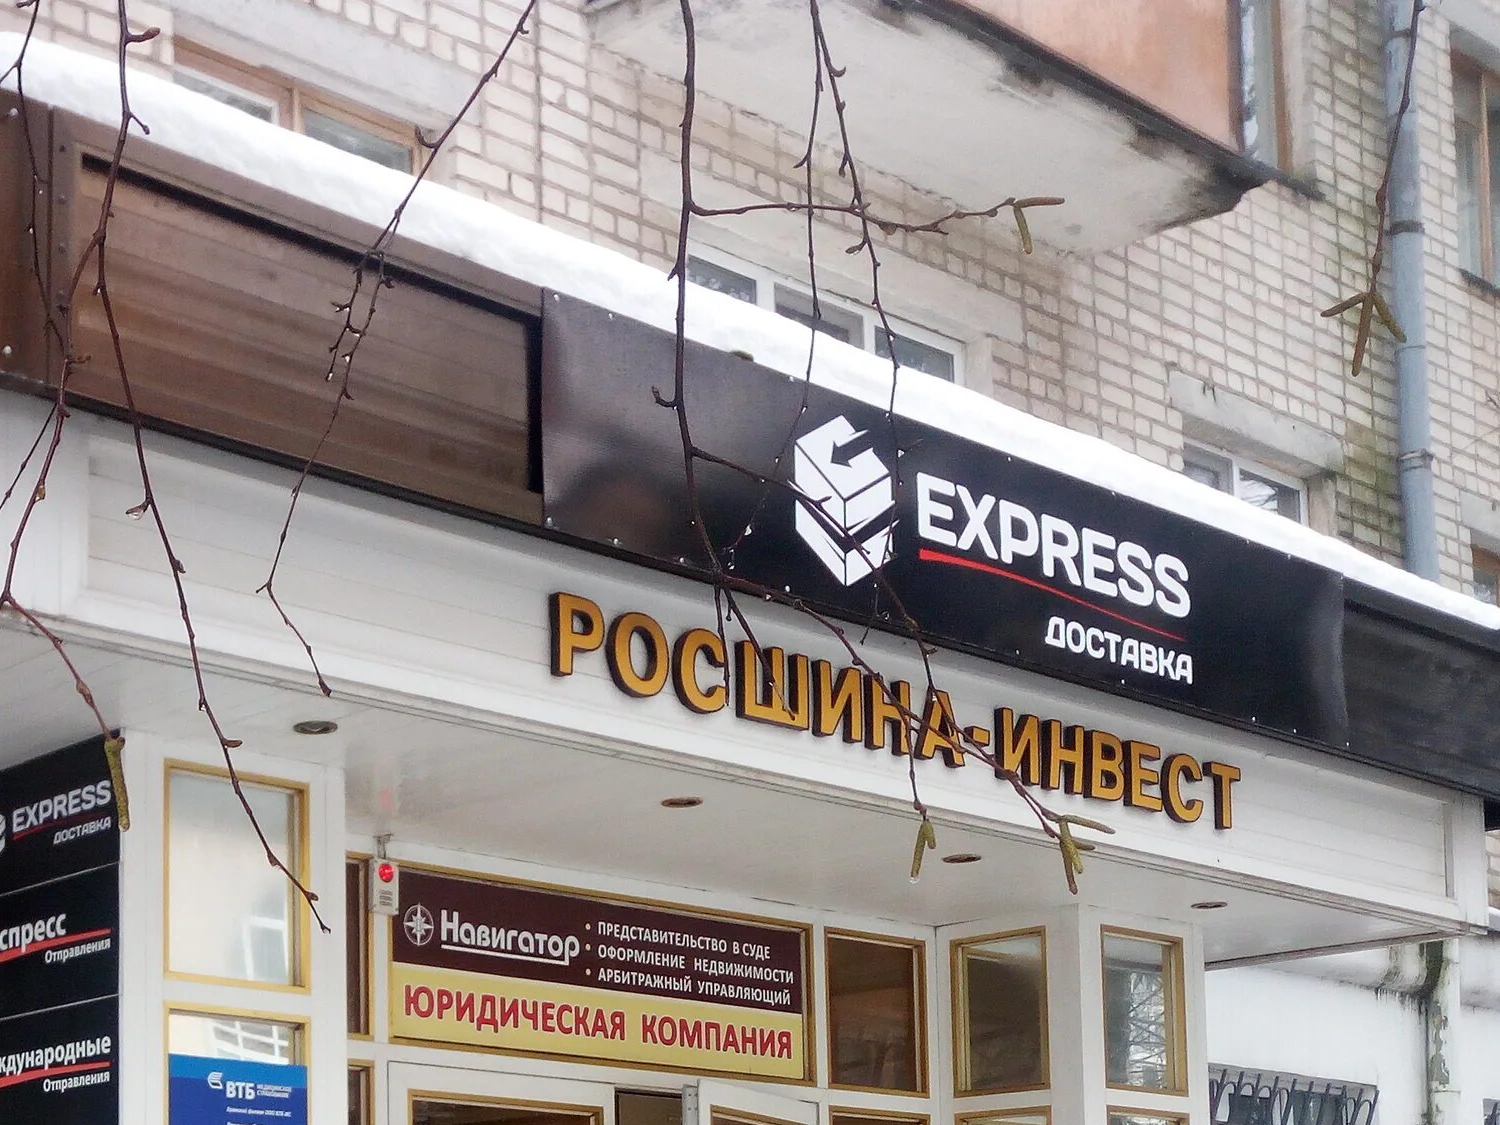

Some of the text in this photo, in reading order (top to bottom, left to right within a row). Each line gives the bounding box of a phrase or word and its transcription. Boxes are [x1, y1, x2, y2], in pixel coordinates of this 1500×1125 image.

[916, 472, 1192, 619] EXPRESS
[1044, 614, 1194, 685] ДОСТАВКА
[550, 591, 1241, 830] РОСШИНА-ИНВЕСТ
[12, 780, 112, 833] EXPRESS
[53, 817, 111, 844] ДОСТАВКА
[44, 937, 111, 965] Отправления
[440, 909, 580, 965] Навигатор
[598, 921, 771, 961] ПРЕДСТАВИТЕЛЬСТВО В СУДЕ
[598, 944, 794, 985] ОФОРМЛЕНИЕ НЕДВИЖИМОСТИ
[598, 967, 791, 1006] АРБИТРАЖНЫЙ УПРАВЛЯЮЩИЙ
[404, 984, 793, 1060] ЮРИДИЧЕСКАЯ КОМПАНИЯ
[43, 1071, 110, 1092] Отправления
[226, 1081, 255, 1100] ВТБ
